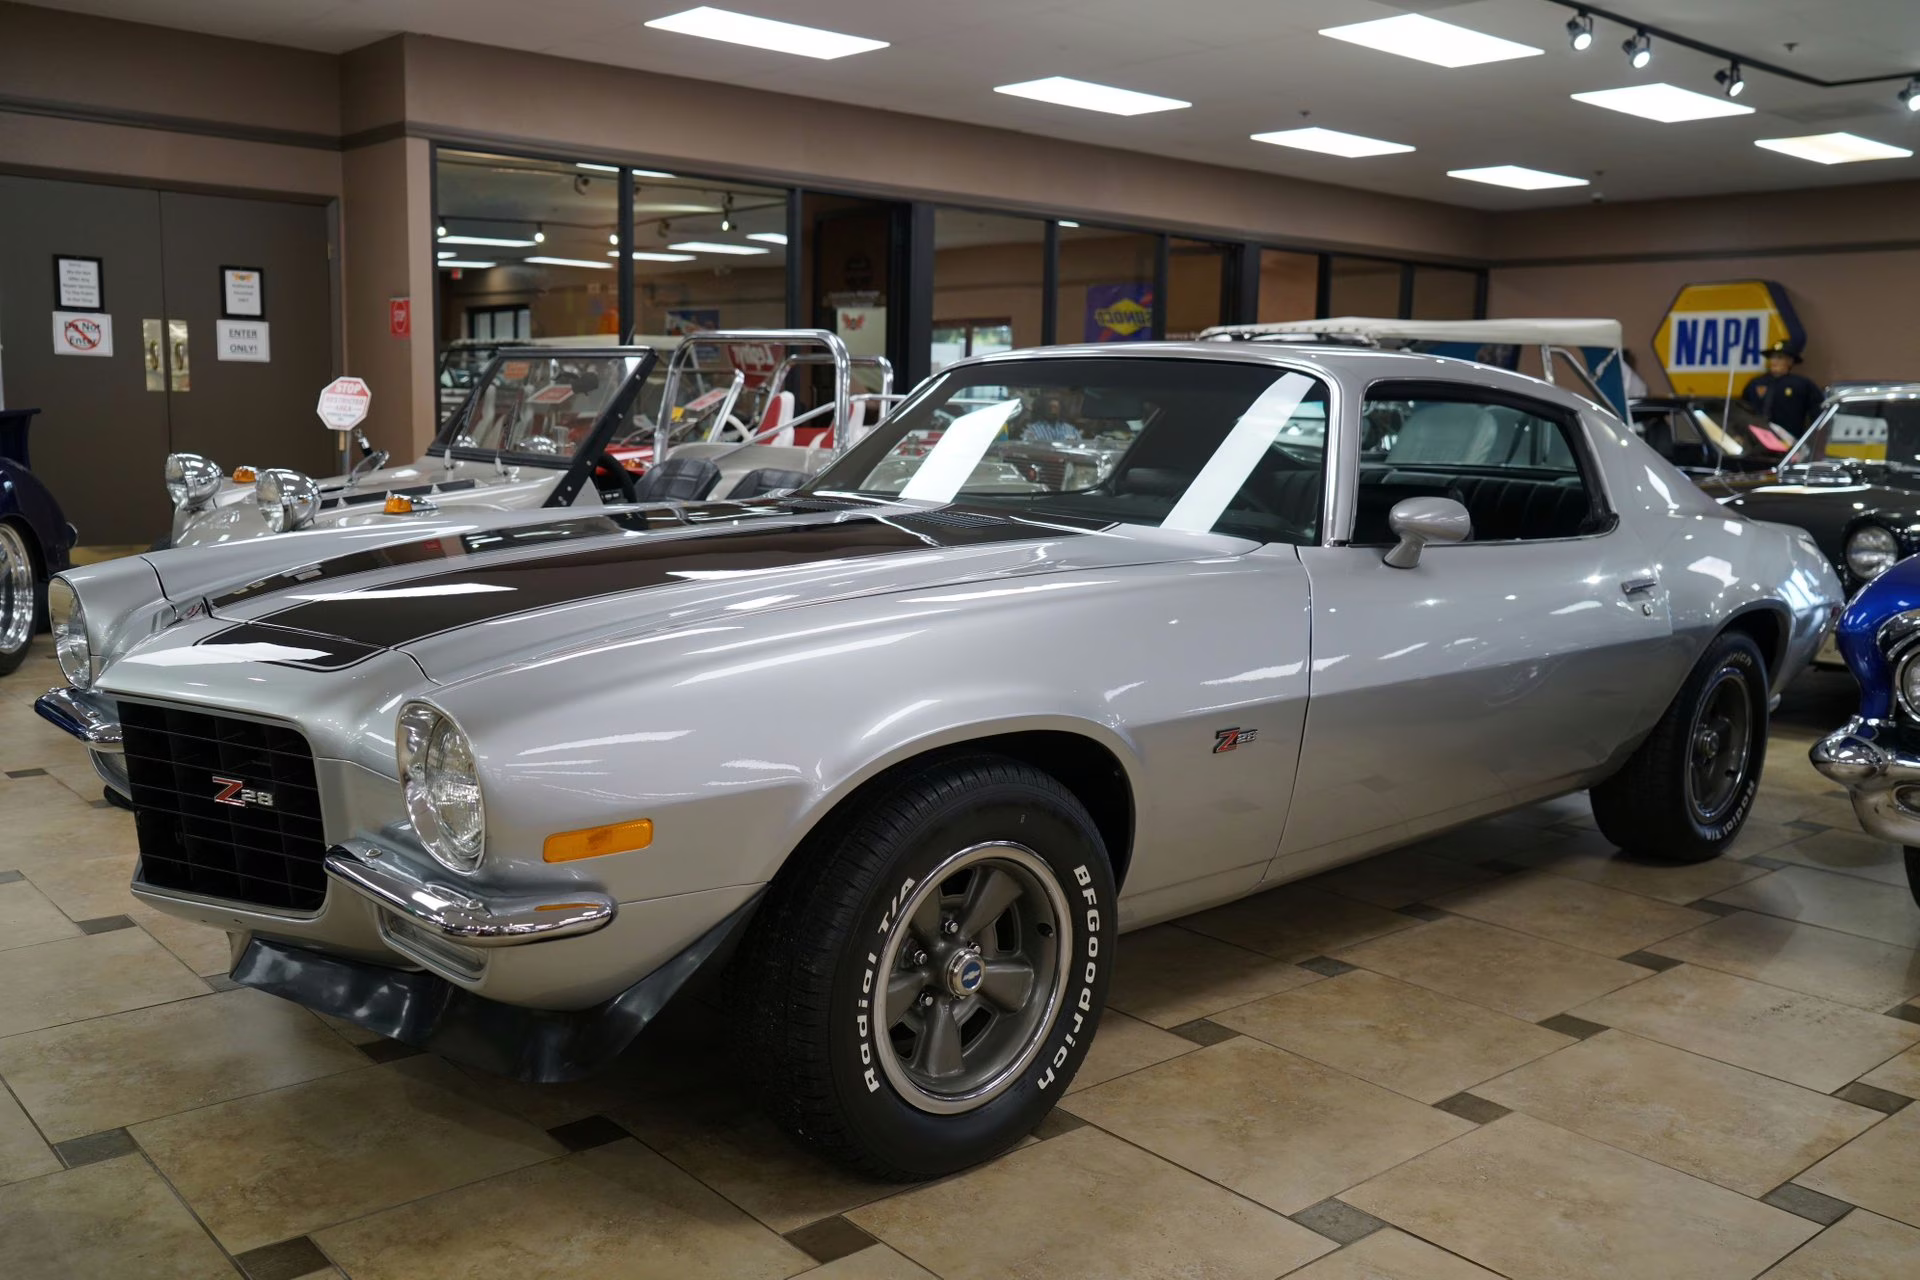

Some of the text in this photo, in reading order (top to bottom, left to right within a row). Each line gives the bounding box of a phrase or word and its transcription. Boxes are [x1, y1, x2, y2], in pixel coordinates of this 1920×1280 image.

[82, 322, 101, 332] Not
[228, 328, 257, 338] ENTER
[230, 344, 257, 355] ONLY!
[1675, 317, 1761, 366] NAPA
[335, 383, 361, 396] STOP
[1213, 727, 1258, 753] Z28
[212, 776, 273, 807] Z28
[1722, 780, 1755, 836] Radial
[857, 877, 916, 1093] Radial T/A
[1037, 864, 1100, 1090] BFGoodrich
